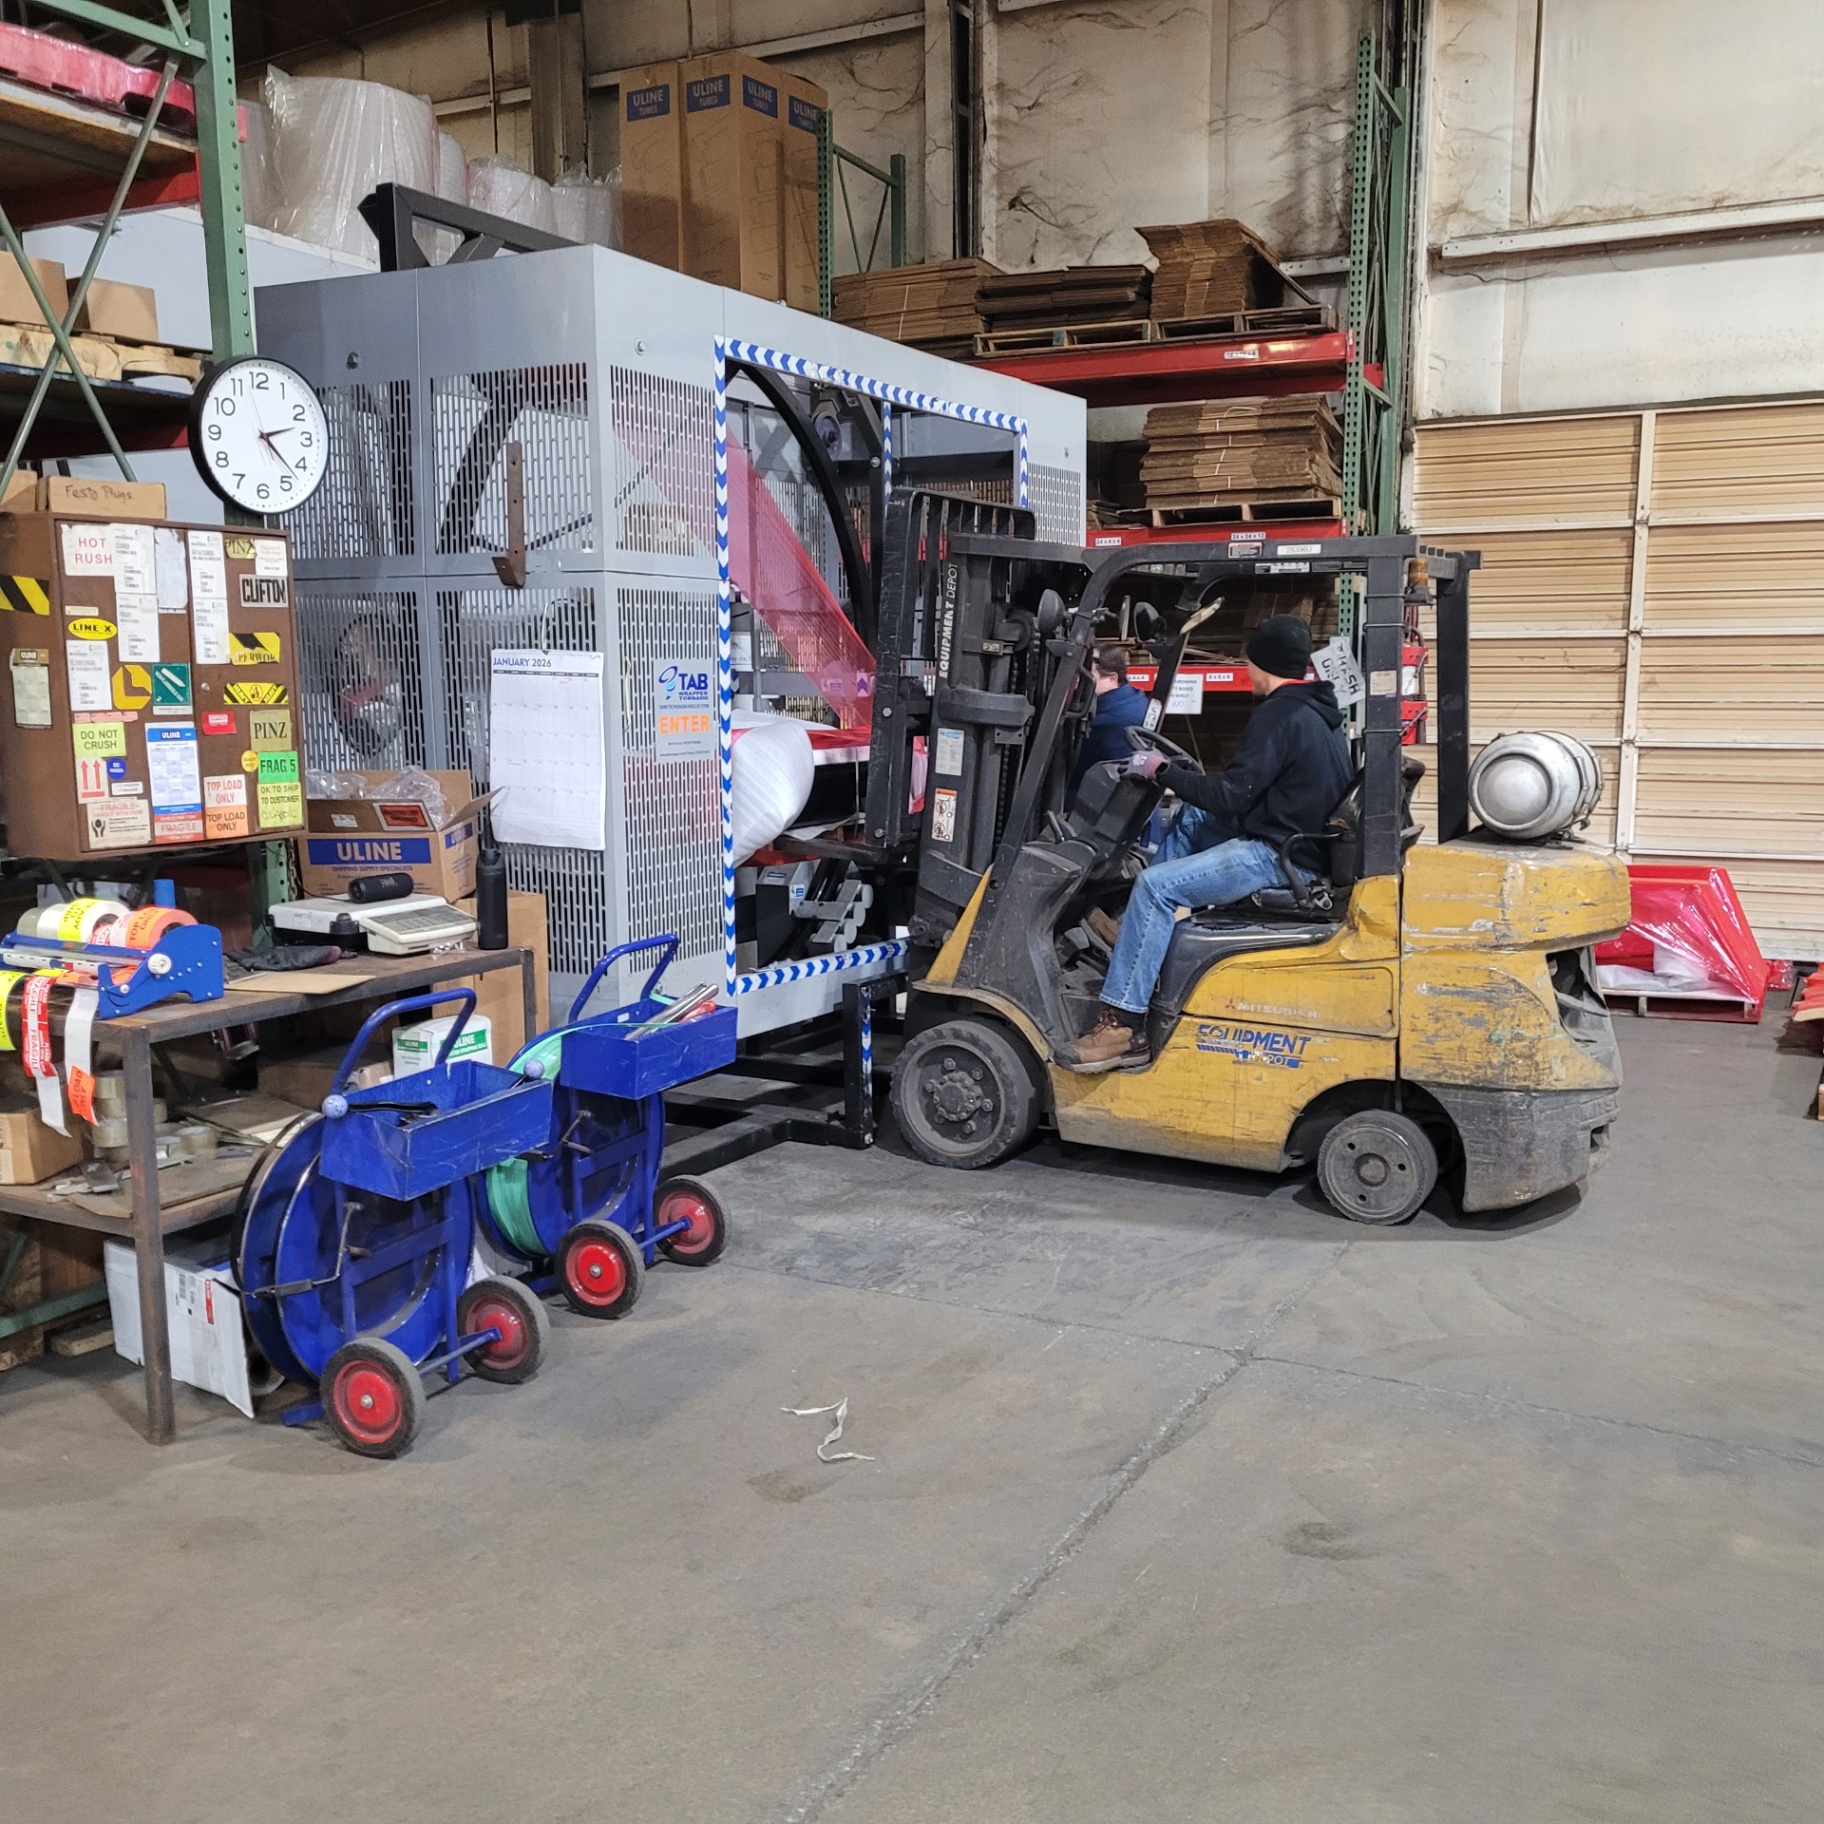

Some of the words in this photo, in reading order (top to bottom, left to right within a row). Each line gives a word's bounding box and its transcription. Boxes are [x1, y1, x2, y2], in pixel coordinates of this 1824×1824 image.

[693, 79, 724, 97] ULINE
[747, 80, 773, 102] ULINE
[633, 89, 664, 106] ULINE
[231, 377, 243, 397] 11
[249, 371, 270, 390] 12
[280, 382, 285, 400] 1
[214, 397, 236, 416] 10
[292, 404, 306, 422] 2
[208, 424, 222, 441] 9
[300, 431, 313, 448] 3
[215, 451, 229, 468] 8
[295, 456, 308, 472] 4
[232, 473, 246, 490] 7
[279, 475, 293, 492] 5
[256, 483, 270, 499] 6
[78, 537, 107, 548] HOT
[75, 553, 113, 564] RUSH
[945, 562, 958, 599] DEPOT
[241, 577, 287, 604] CLIFTON
[939, 600, 954, 679] EQUIPMENT
[493, 657, 530, 667] JANUARY
[532, 658, 552, 668] 2026
[678, 673, 709, 690] TAB
[253, 721, 288, 740] PINZ
[659, 715, 710, 735] ENTER
[80, 730, 95, 740] DO
[98, 729, 118, 739] NOT
[161, 731, 181, 739] ULINE
[84, 740, 117, 750] CRUSH
[260, 759, 287, 773] FRAG
[289, 758, 296, 773] 5
[207, 780, 222, 791] TOP
[222, 779, 243, 790] LOAD
[260, 785, 271, 794] OK
[272, 785, 282, 793] TO
[283, 784, 299, 792] SHIP
[215, 792, 235, 804] ONLY
[270, 794, 300, 804] CUSTOMER
[207, 813, 222, 823] TOP
[224, 811, 246, 821] LOAD
[160, 822, 197, 833] FRAGILE
[216, 821, 238, 832] ONLY
[336, 842, 403, 861] ULINE
[1198, 1024, 1312, 1055] EQUIPMENT
[29, 1028, 40, 1072] FRAGILE
